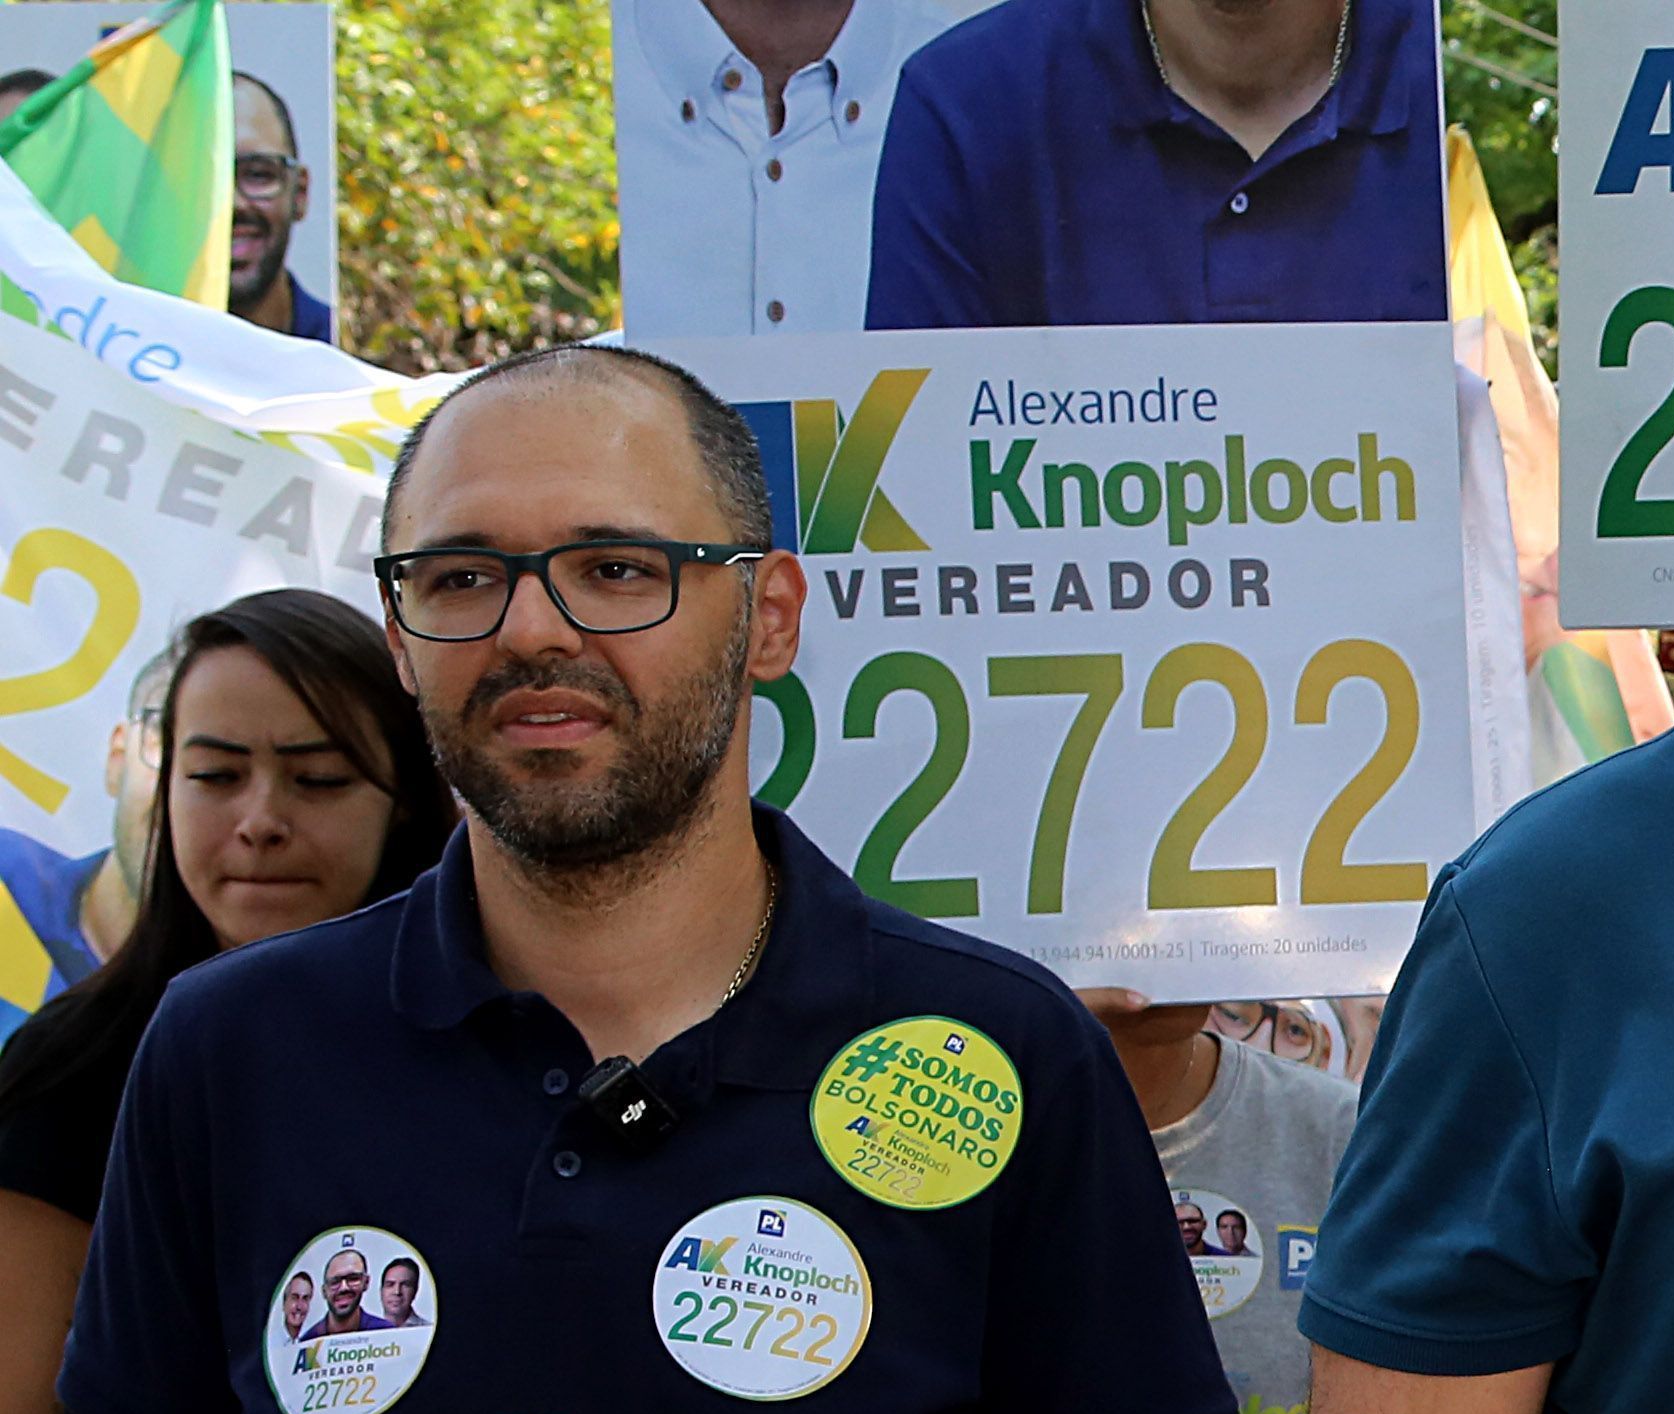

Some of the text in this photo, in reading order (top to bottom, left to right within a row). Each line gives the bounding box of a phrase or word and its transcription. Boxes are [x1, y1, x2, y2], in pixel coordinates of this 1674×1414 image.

[969, 377, 1219, 427] Alexandre
[969, 433, 1417, 546] Knoploch
[824, 557, 1271, 619] VEREADOR
[1199, 938, 1270, 961] Tiragem:
[1273, 938, 1292, 955] 20
[1295, 934, 1368, 954] unidades
[842, 1036, 1018, 1114] #SOMOS
[825, 1079, 998, 1169] BOLSONARO
[889, 1073, 1004, 1142] TODOS
[848, 1148, 923, 1199] 22722
[761, 1214, 783, 1232] PL
[743, 1255, 859, 1296] Knoploch
[747, 1242, 813, 1264] Alexandre
[702, 1275, 818, 1306] VEREADOR
[327, 1342, 401, 1364] Knoploch
[667, 1290, 838, 1367] 22722
[302, 1375, 379, 1412] 22722
